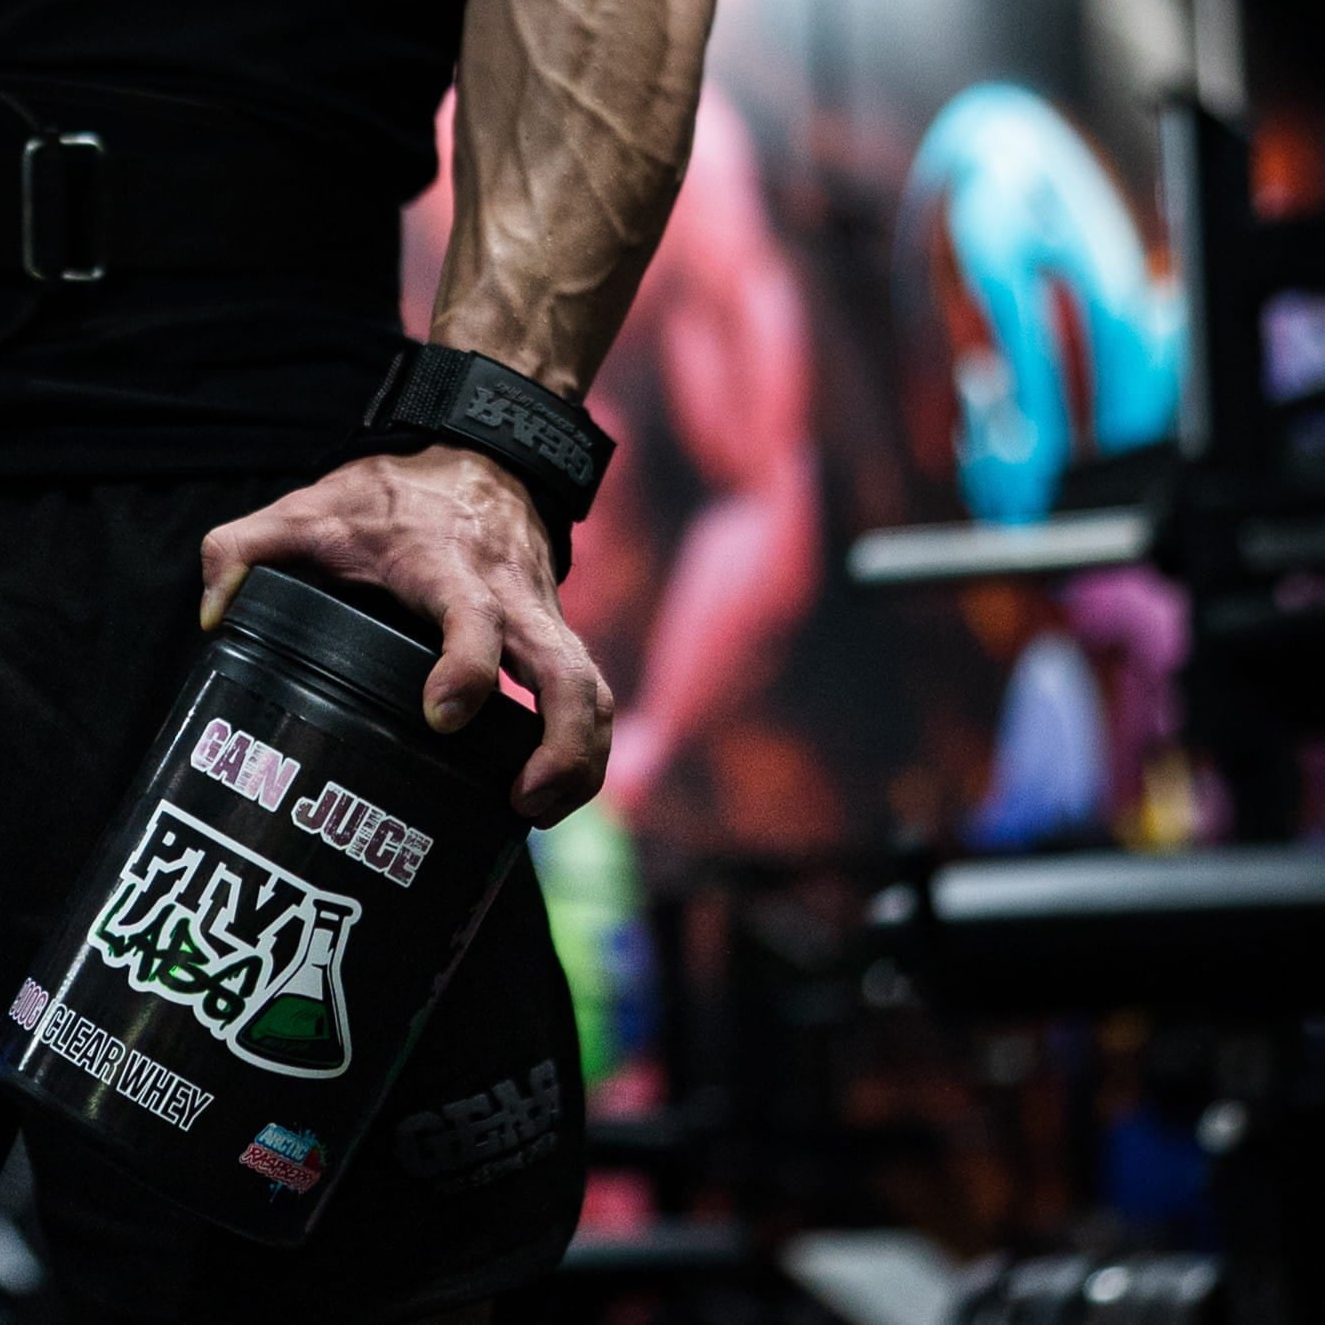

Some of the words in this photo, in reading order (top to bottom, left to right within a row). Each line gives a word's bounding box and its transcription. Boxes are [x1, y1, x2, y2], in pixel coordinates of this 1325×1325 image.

[191, 717, 301, 813] GAIN
[291, 780, 434, 888] JUICE
[87, 880, 266, 1036] LABS
[41, 1002, 125, 1086] CLEAR
[116, 1049, 216, 1133] WHEY
[254, 1123, 311, 1165] ARCTIC
